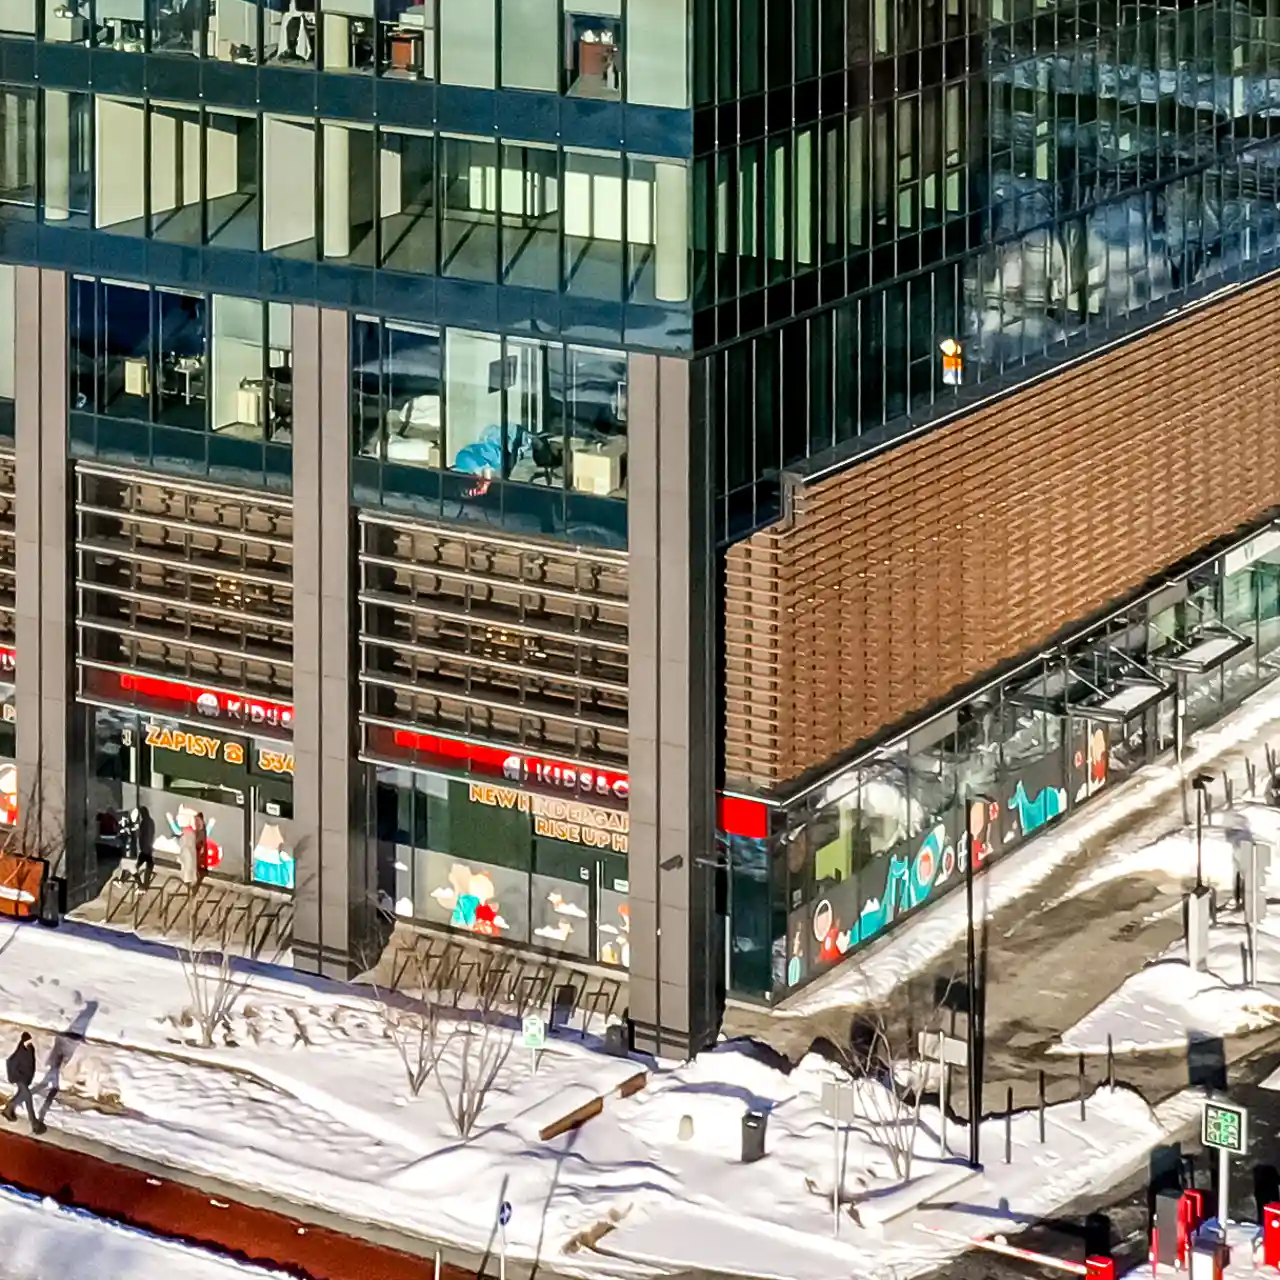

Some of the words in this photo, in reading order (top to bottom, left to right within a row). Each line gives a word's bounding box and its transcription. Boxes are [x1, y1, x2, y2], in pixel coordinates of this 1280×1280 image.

[145, 725, 220, 759] ZAPISY
[468, 782, 519, 811] NEW
[535, 815, 580, 843] RISE
